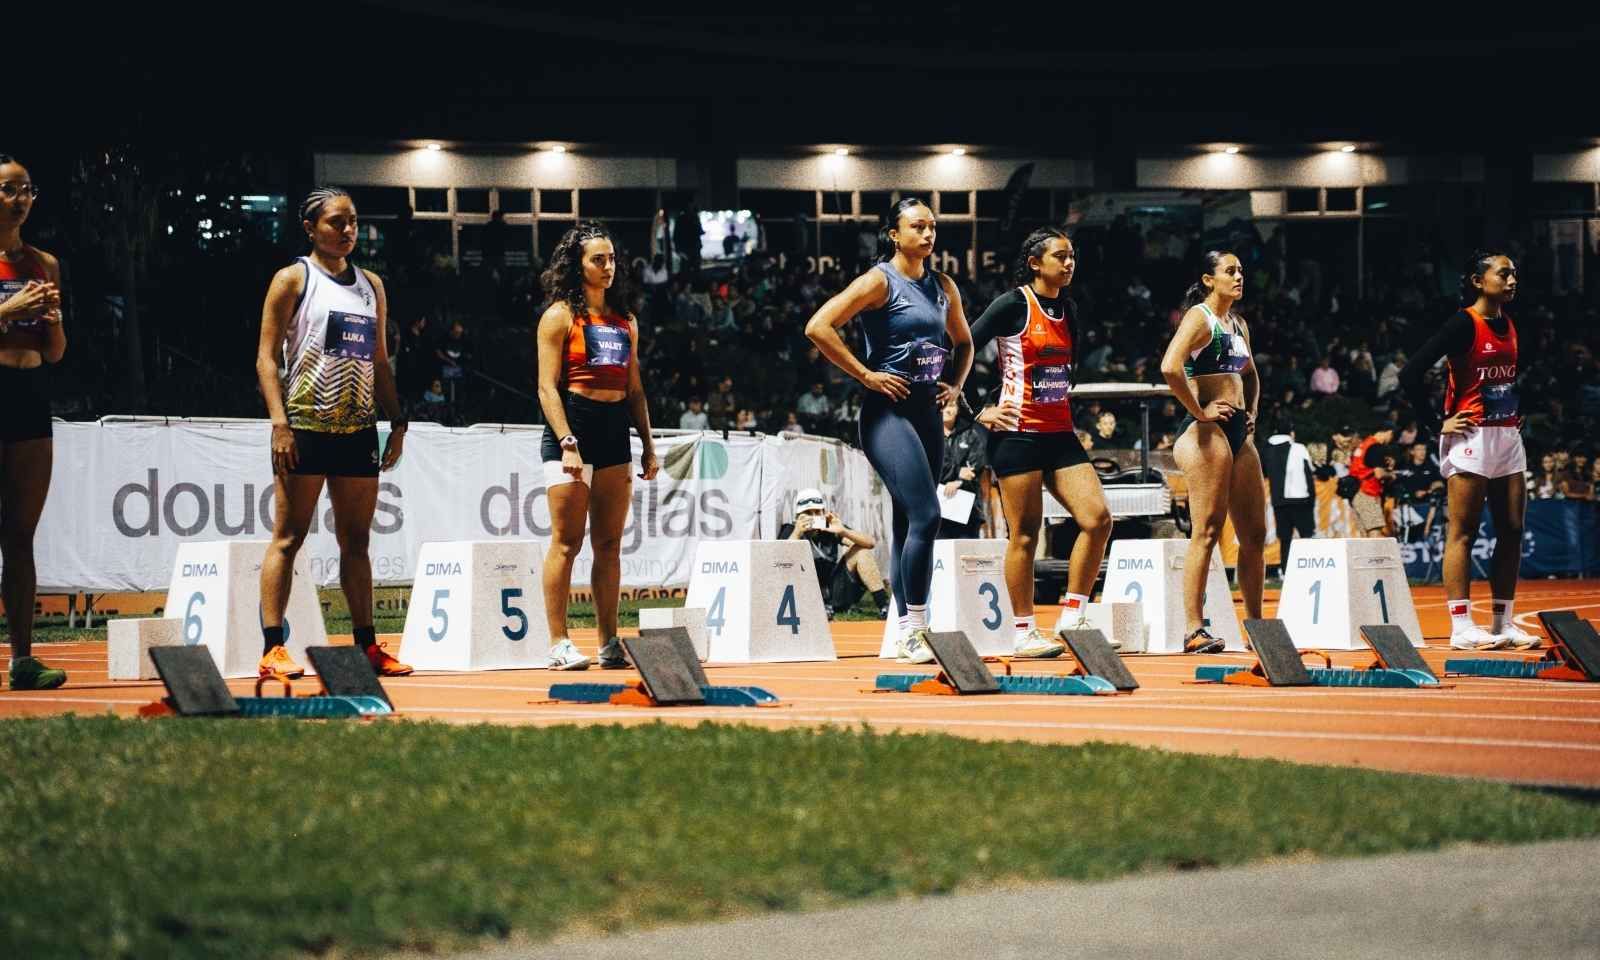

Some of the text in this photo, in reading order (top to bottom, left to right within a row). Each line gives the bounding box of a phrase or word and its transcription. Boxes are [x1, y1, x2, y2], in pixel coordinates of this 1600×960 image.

[342, 331, 365, 343] LUKA
[598, 341, 623, 351] VALET
[1477, 365, 1516, 380] TONG
[112, 467, 404, 538] dous
[182, 561, 218, 577] DIMA
[425, 563, 462, 576] DIMA
[701, 561, 739, 574] DIMA
[1117, 558, 1155, 570] DIMA
[1297, 557, 1336, 569] DIMA
[183, 591, 206, 646] 6
[427, 589, 450, 642] 5
[501, 588, 529, 642] 5
[706, 586, 726, 636] 4
[776, 584, 800, 634] 4
[978, 582, 1002, 631] 3
[1308, 580, 1322, 625] 1
[1372, 579, 1389, 624] 1
